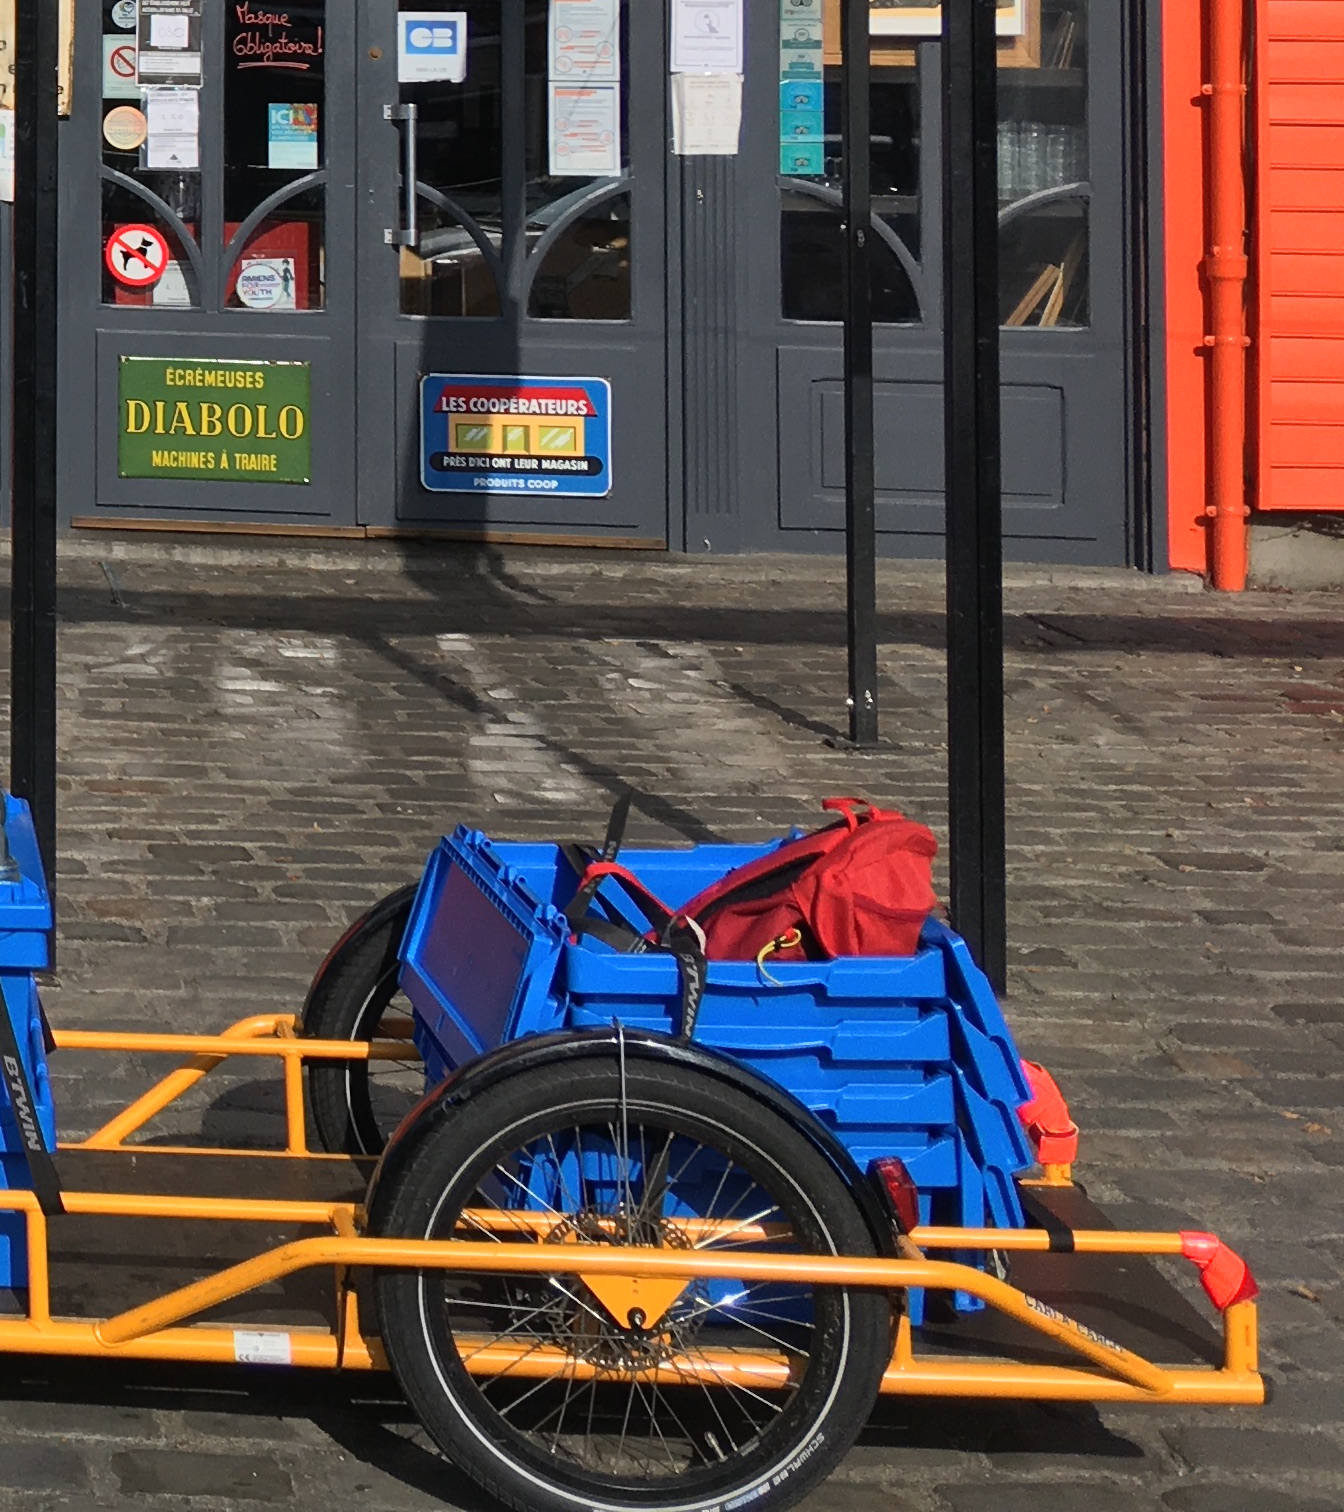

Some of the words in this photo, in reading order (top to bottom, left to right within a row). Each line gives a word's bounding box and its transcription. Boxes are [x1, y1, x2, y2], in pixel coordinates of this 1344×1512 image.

[235, 0, 293, 37] Masque
[409, 27, 453, 48] CB
[271, 109, 295, 126] ICI
[441, 396, 467, 413] LES
[469, 395, 589, 416] COOPÉRATEURS
[124, 398, 305, 439] DIABOLO
[151, 449, 216, 470] MACHINES
[219, 448, 229, 470] À
[234, 452, 278, 472] TRAIRE
[443, 455, 467, 468] PRÈS
[468, 457, 490, 469] D'ICI
[491, 458, 512, 470] ONT
[514, 458, 539, 470] LEUR
[541, 459, 589, 471] MAGASIN
[473, 476, 526, 489] PRODUITS
[527, 479, 559, 490] COOP
[3, 1055, 42, 1152] BTWIN
